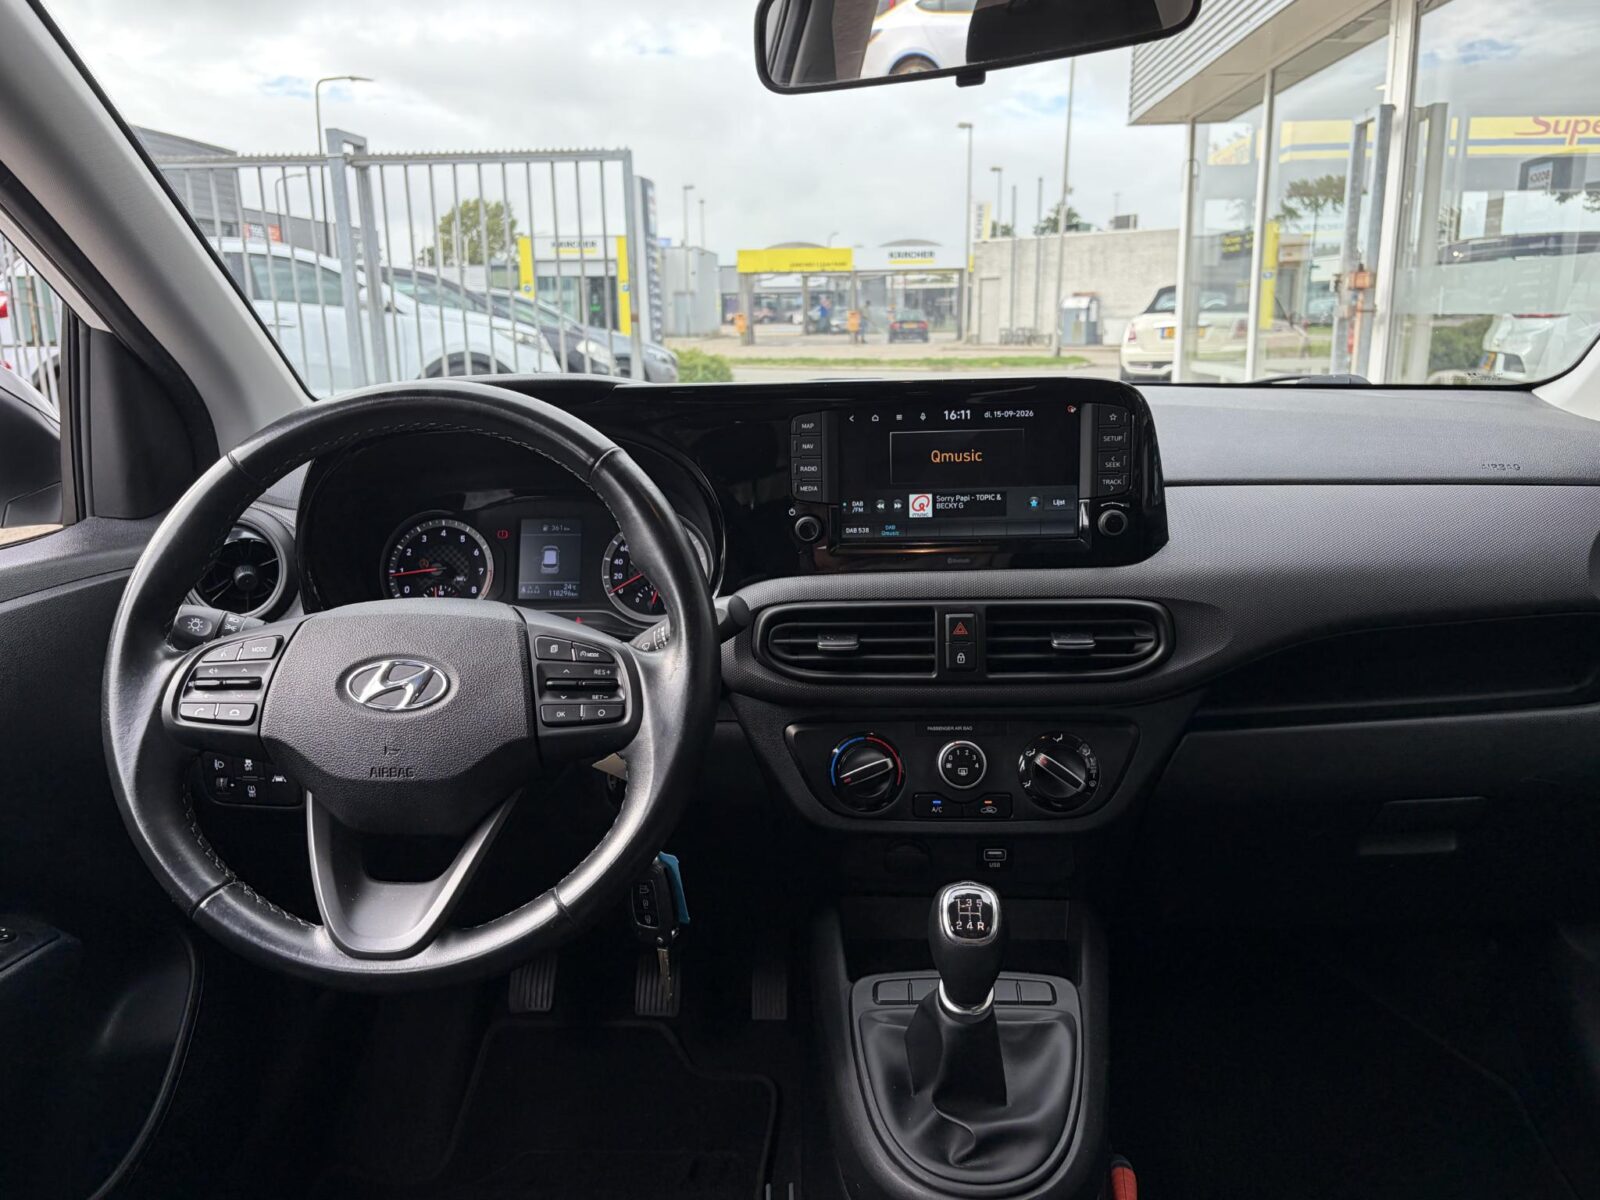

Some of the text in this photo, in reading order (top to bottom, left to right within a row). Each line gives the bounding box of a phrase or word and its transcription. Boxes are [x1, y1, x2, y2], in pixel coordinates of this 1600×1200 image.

[943, 409, 971, 420] 16:11
[994, 410, 1034, 418] 15-09-2026
[931, 449, 983, 463] Qmusic
[936, 495, 954, 503] Sorry
[955, 494, 970, 502] Papi
[440, 529, 446, 537] 4
[858, 526, 870, 534] 538
[421, 535, 427, 543] 3
[460, 535, 466, 543] 5
[406, 548, 412, 556] 2
[473, 548, 479, 556] 6
[478, 567, 484, 575] 7
[404, 585, 410, 594] 0
[471, 586, 477, 594] 8
[369, 766, 414, 778] AIRBAG
[966, 899, 973, 907] 3
[976, 899, 983, 907] 5
[956, 922, 963, 930] 2
[977, 922, 985, 931] R
